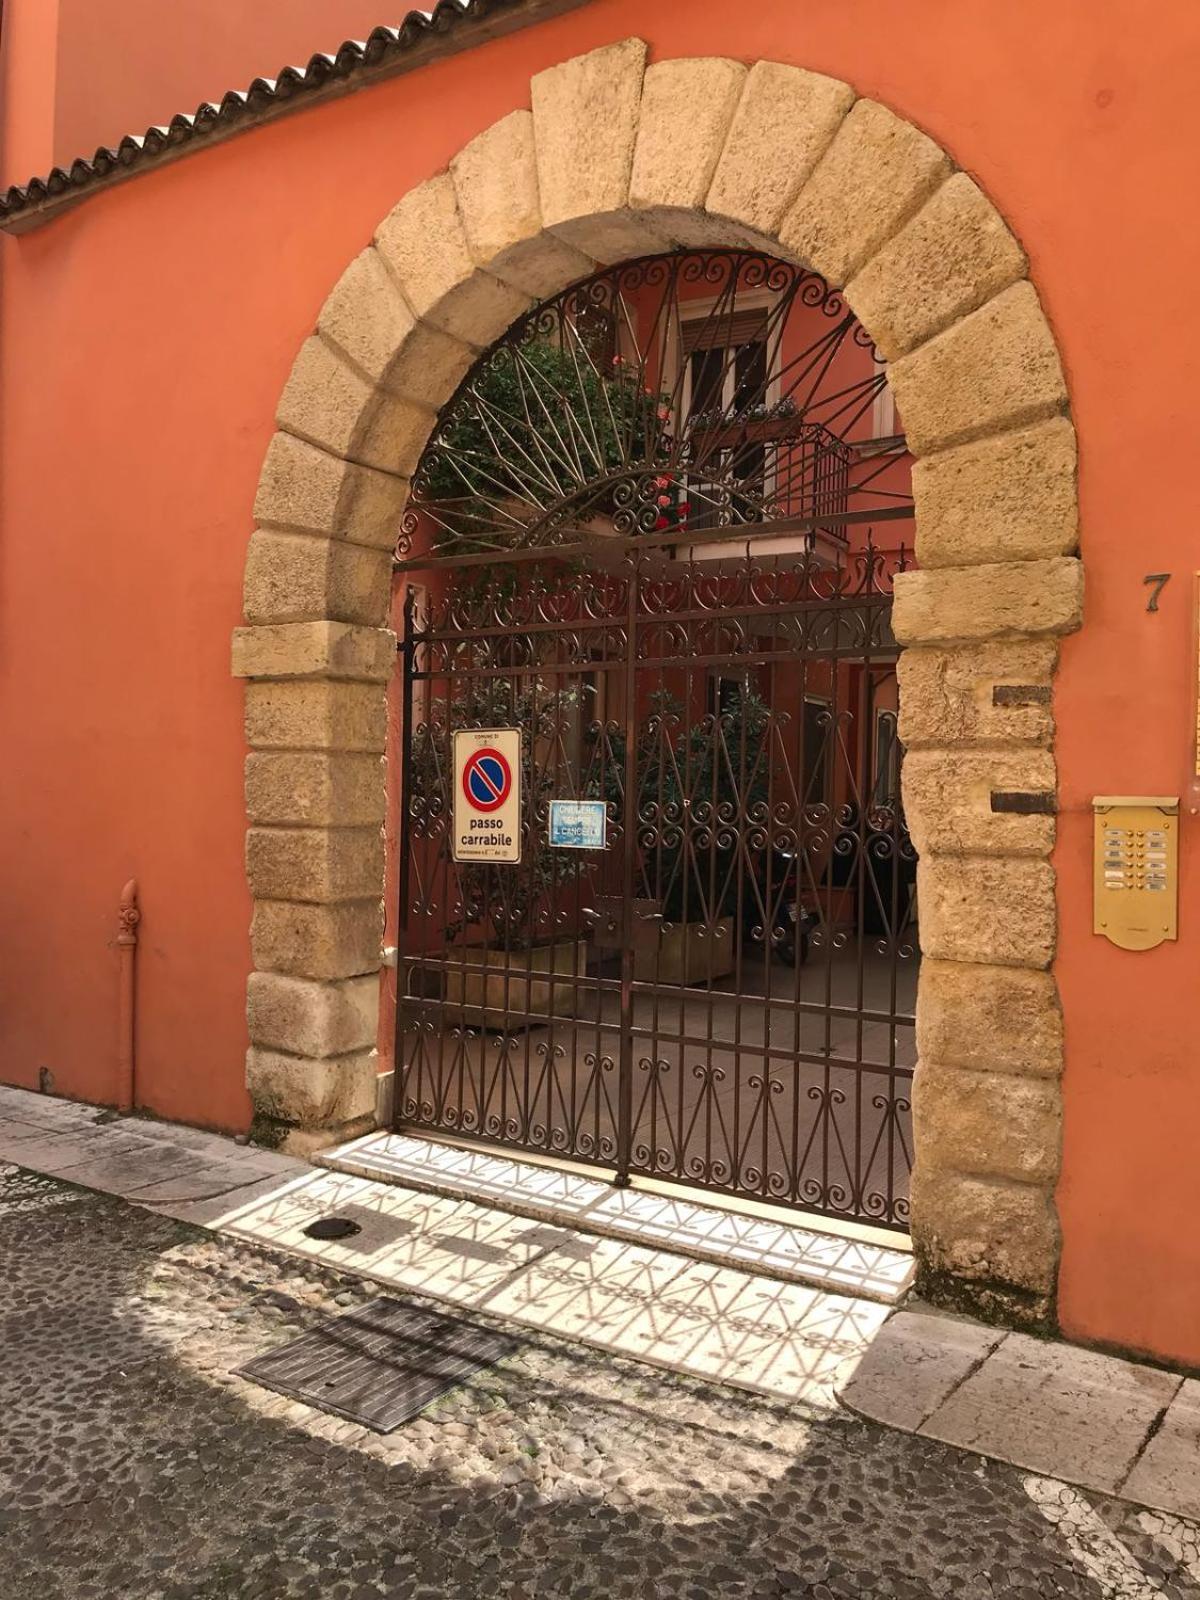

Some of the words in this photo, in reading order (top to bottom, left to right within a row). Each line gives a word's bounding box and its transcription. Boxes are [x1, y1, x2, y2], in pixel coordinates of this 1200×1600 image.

[1143, 573, 1171, 613] 7
[470, 818, 503, 831] passo
[461, 833, 512, 846] carrabile
